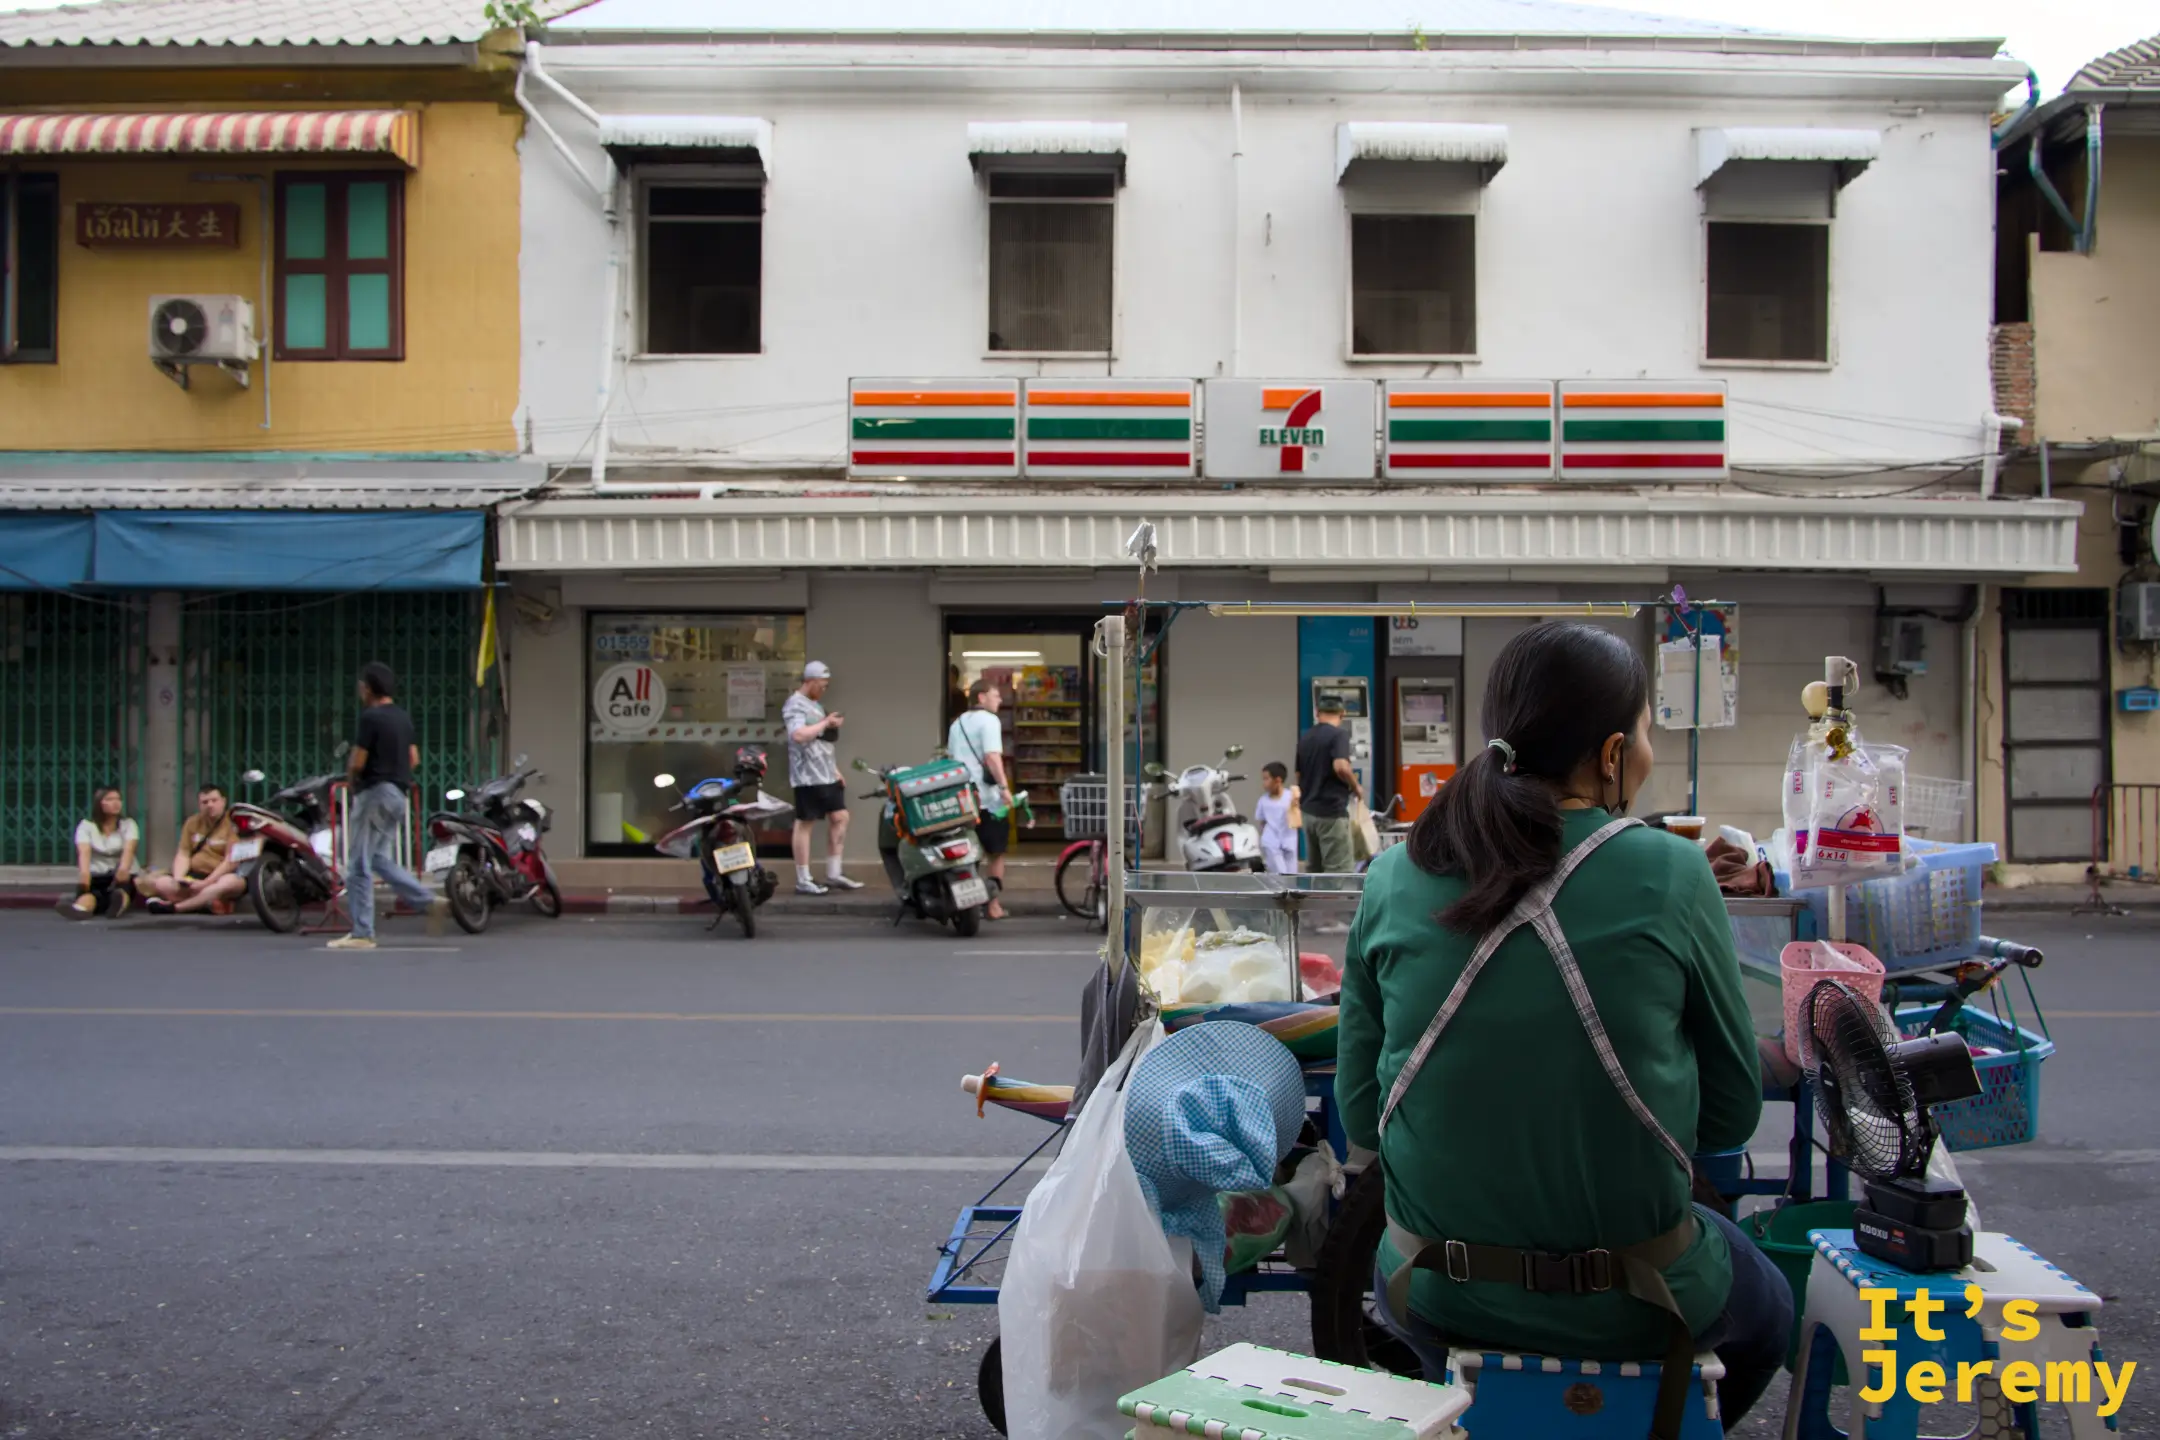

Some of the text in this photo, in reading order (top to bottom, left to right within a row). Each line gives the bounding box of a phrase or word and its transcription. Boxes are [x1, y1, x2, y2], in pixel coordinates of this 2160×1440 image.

[164, 209, 223, 238] 大生
[1262, 388, 1322, 472] 7
[597, 635, 650, 649] 01559
[609, 667, 652, 702] All
[609, 703, 652, 717] Cafe
